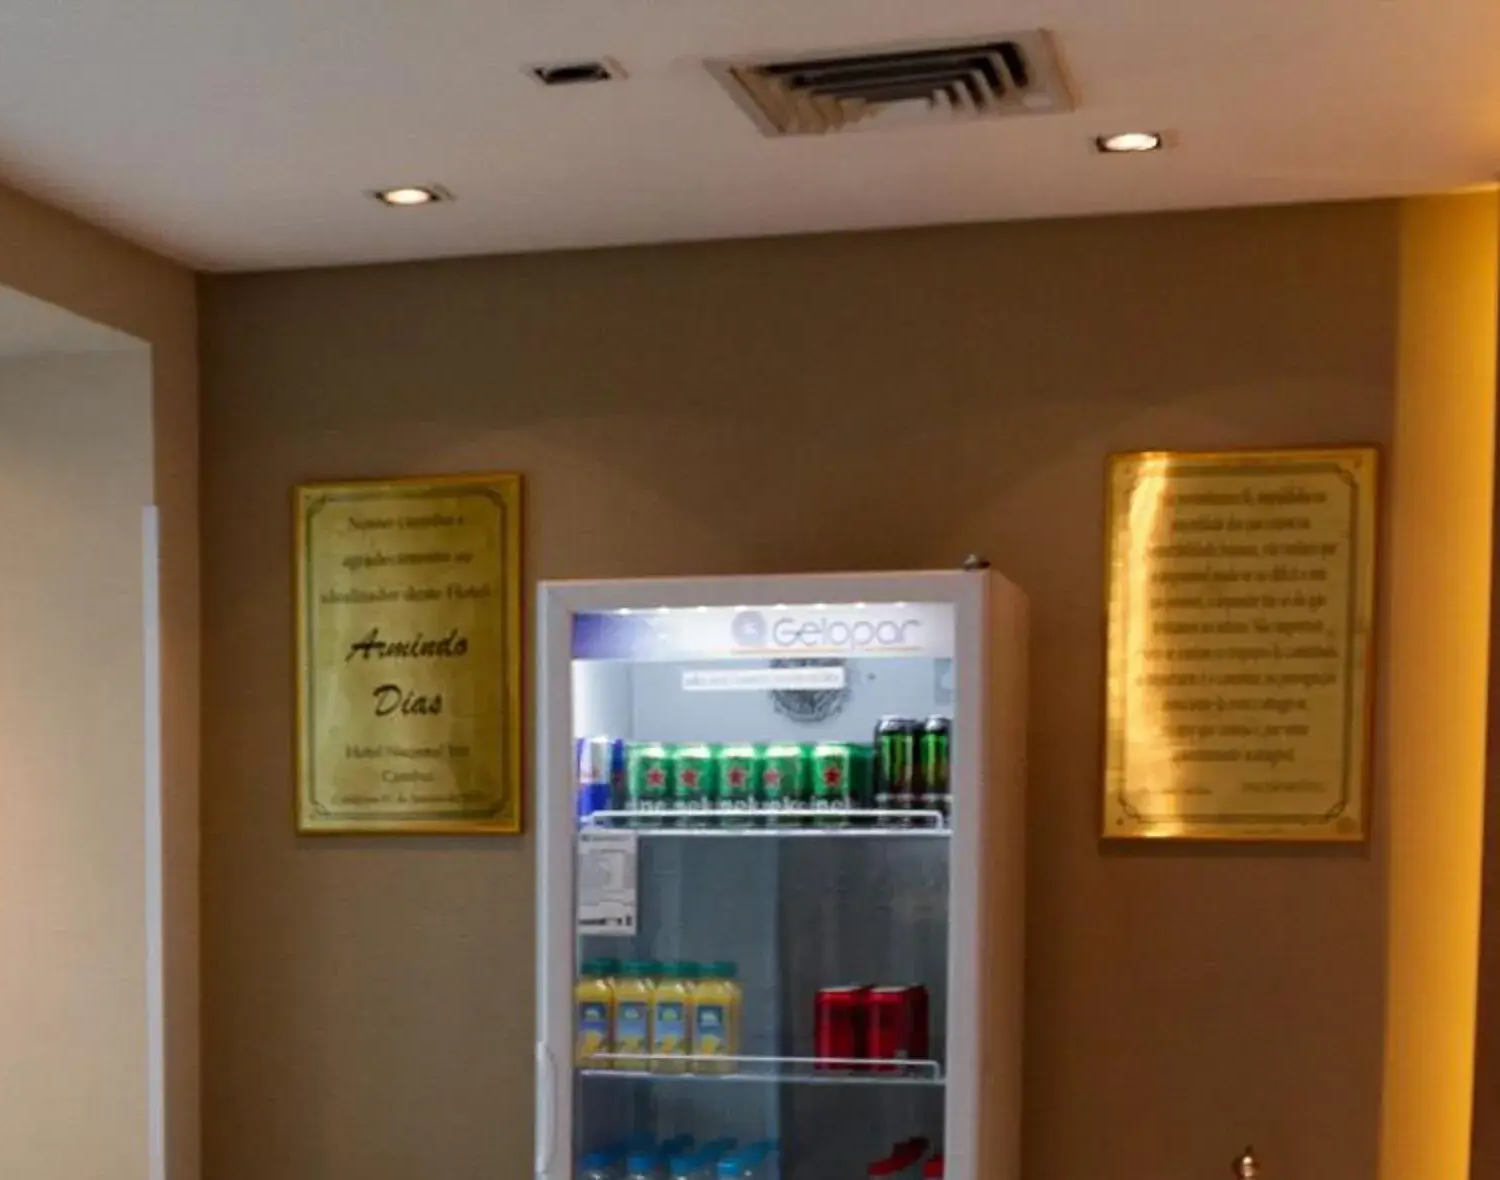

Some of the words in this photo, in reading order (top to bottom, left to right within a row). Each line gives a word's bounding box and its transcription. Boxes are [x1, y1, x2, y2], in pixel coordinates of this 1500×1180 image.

[344, 627, 469, 662] Armindo
[772, 615, 922, 649] Gelopar
[372, 684, 443, 716] Dias
